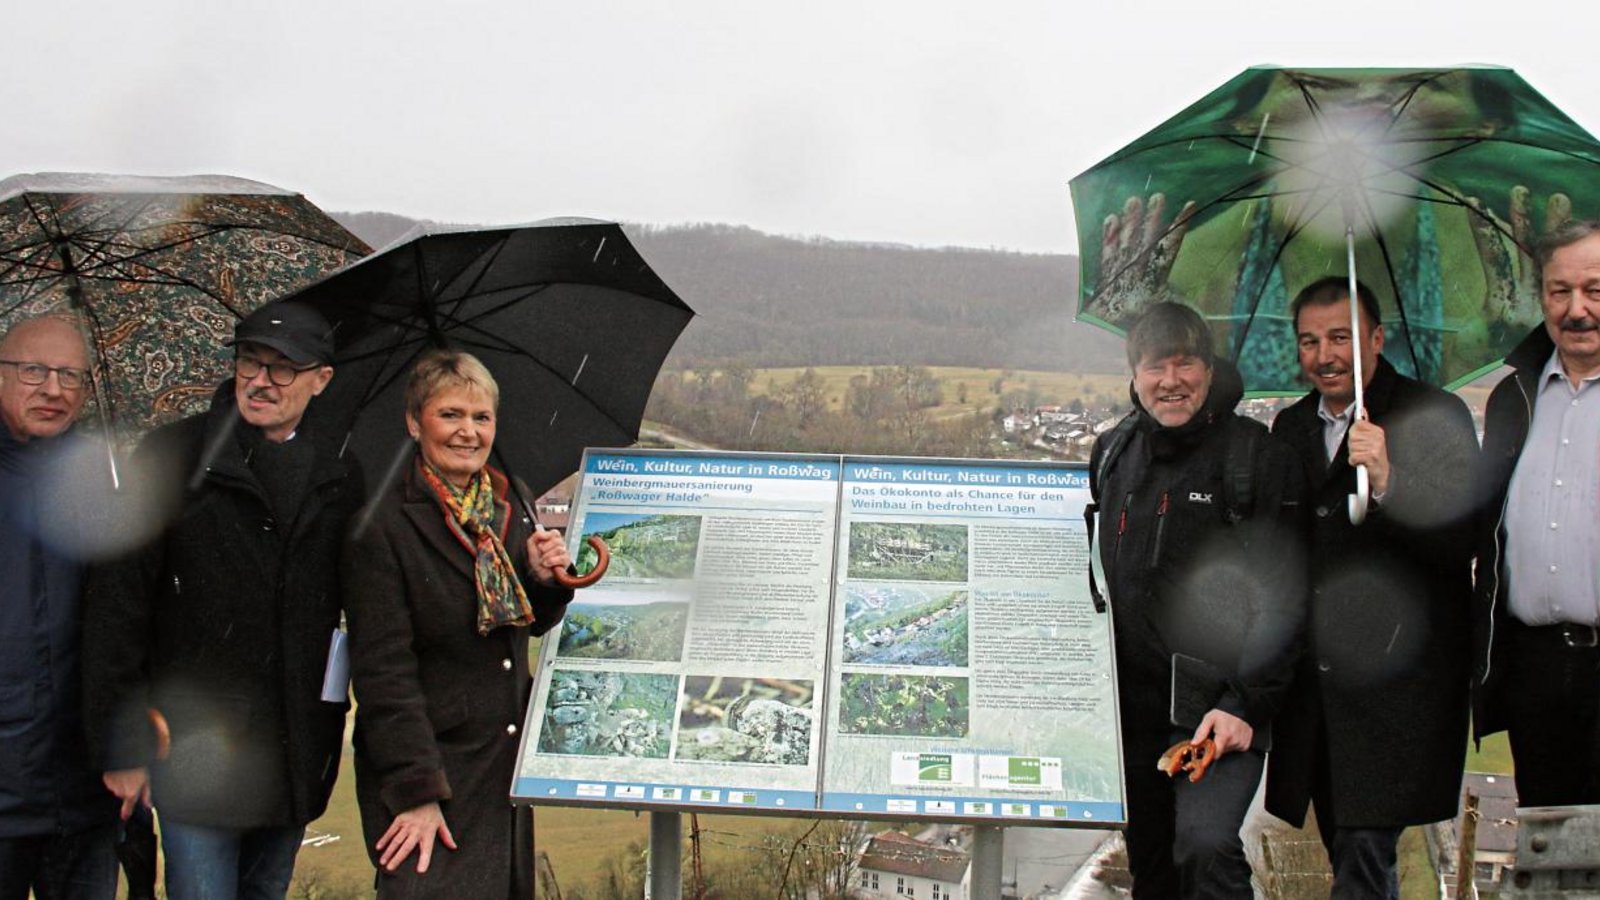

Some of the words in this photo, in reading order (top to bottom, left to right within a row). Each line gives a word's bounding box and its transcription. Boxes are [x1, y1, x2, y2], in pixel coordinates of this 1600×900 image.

[597, 459, 638, 472] Wein,
[644, 461, 693, 474] Kultur,
[699, 463, 743, 475] Natur
[749, 464, 762, 475] in
[768, 465, 832, 479] Roßwag
[592, 477, 753, 493] Weinbergmauersanierung
[854, 467, 896, 481] Wein,
[902, 469, 952, 483] Kultur,
[958, 471, 1001, 483] Natur
[1008, 472, 1021, 484] in
[1027, 472, 1090, 488] Roßwag
[852, 486, 874, 496] Das
[880, 485, 941, 498] Ökokonto
[947, 488, 964, 499] als
[968, 489, 1013, 500] Chance
[1018, 490, 1036, 501] für
[1040, 491, 1064, 501] den
[1189, 492, 1213, 504] DLX
[851, 499, 907, 510] Weinbau
[911, 499, 922, 510] in
[927, 501, 993, 512] bedrohten
[997, 503, 1036, 514] Lagen
